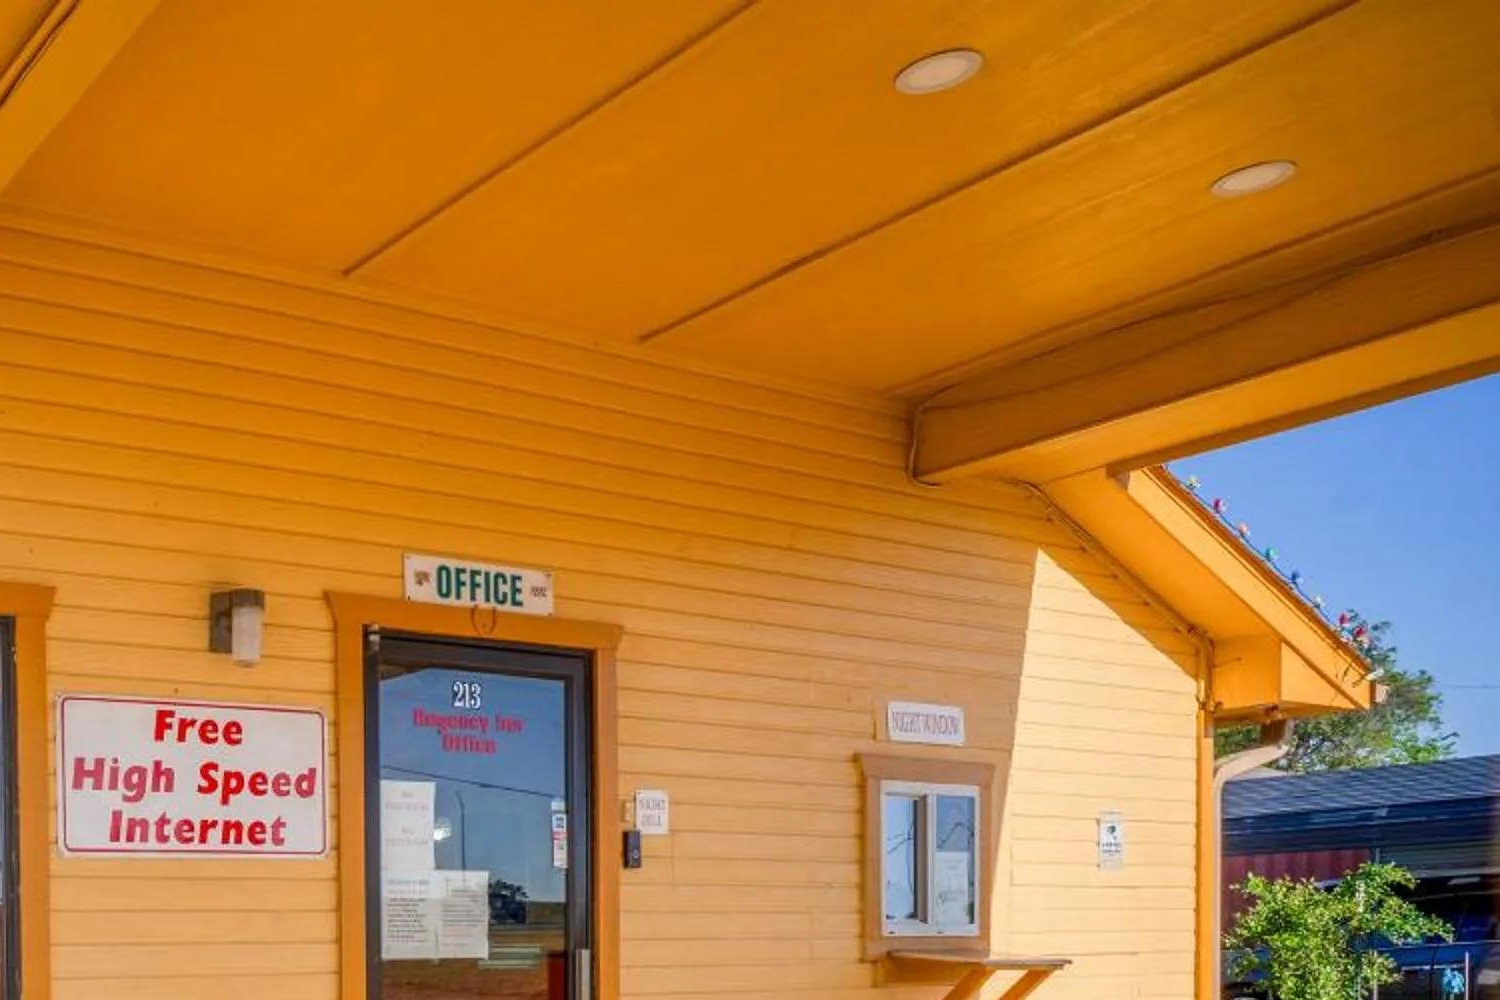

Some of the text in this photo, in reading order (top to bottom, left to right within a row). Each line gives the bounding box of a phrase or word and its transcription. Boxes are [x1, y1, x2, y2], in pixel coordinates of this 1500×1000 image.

[436, 565, 524, 607] OFFICE
[452, 681, 482, 709] 213
[153, 709, 243, 745] Free
[71, 756, 317, 806] High Speed
[108, 809, 287, 846] Internet
